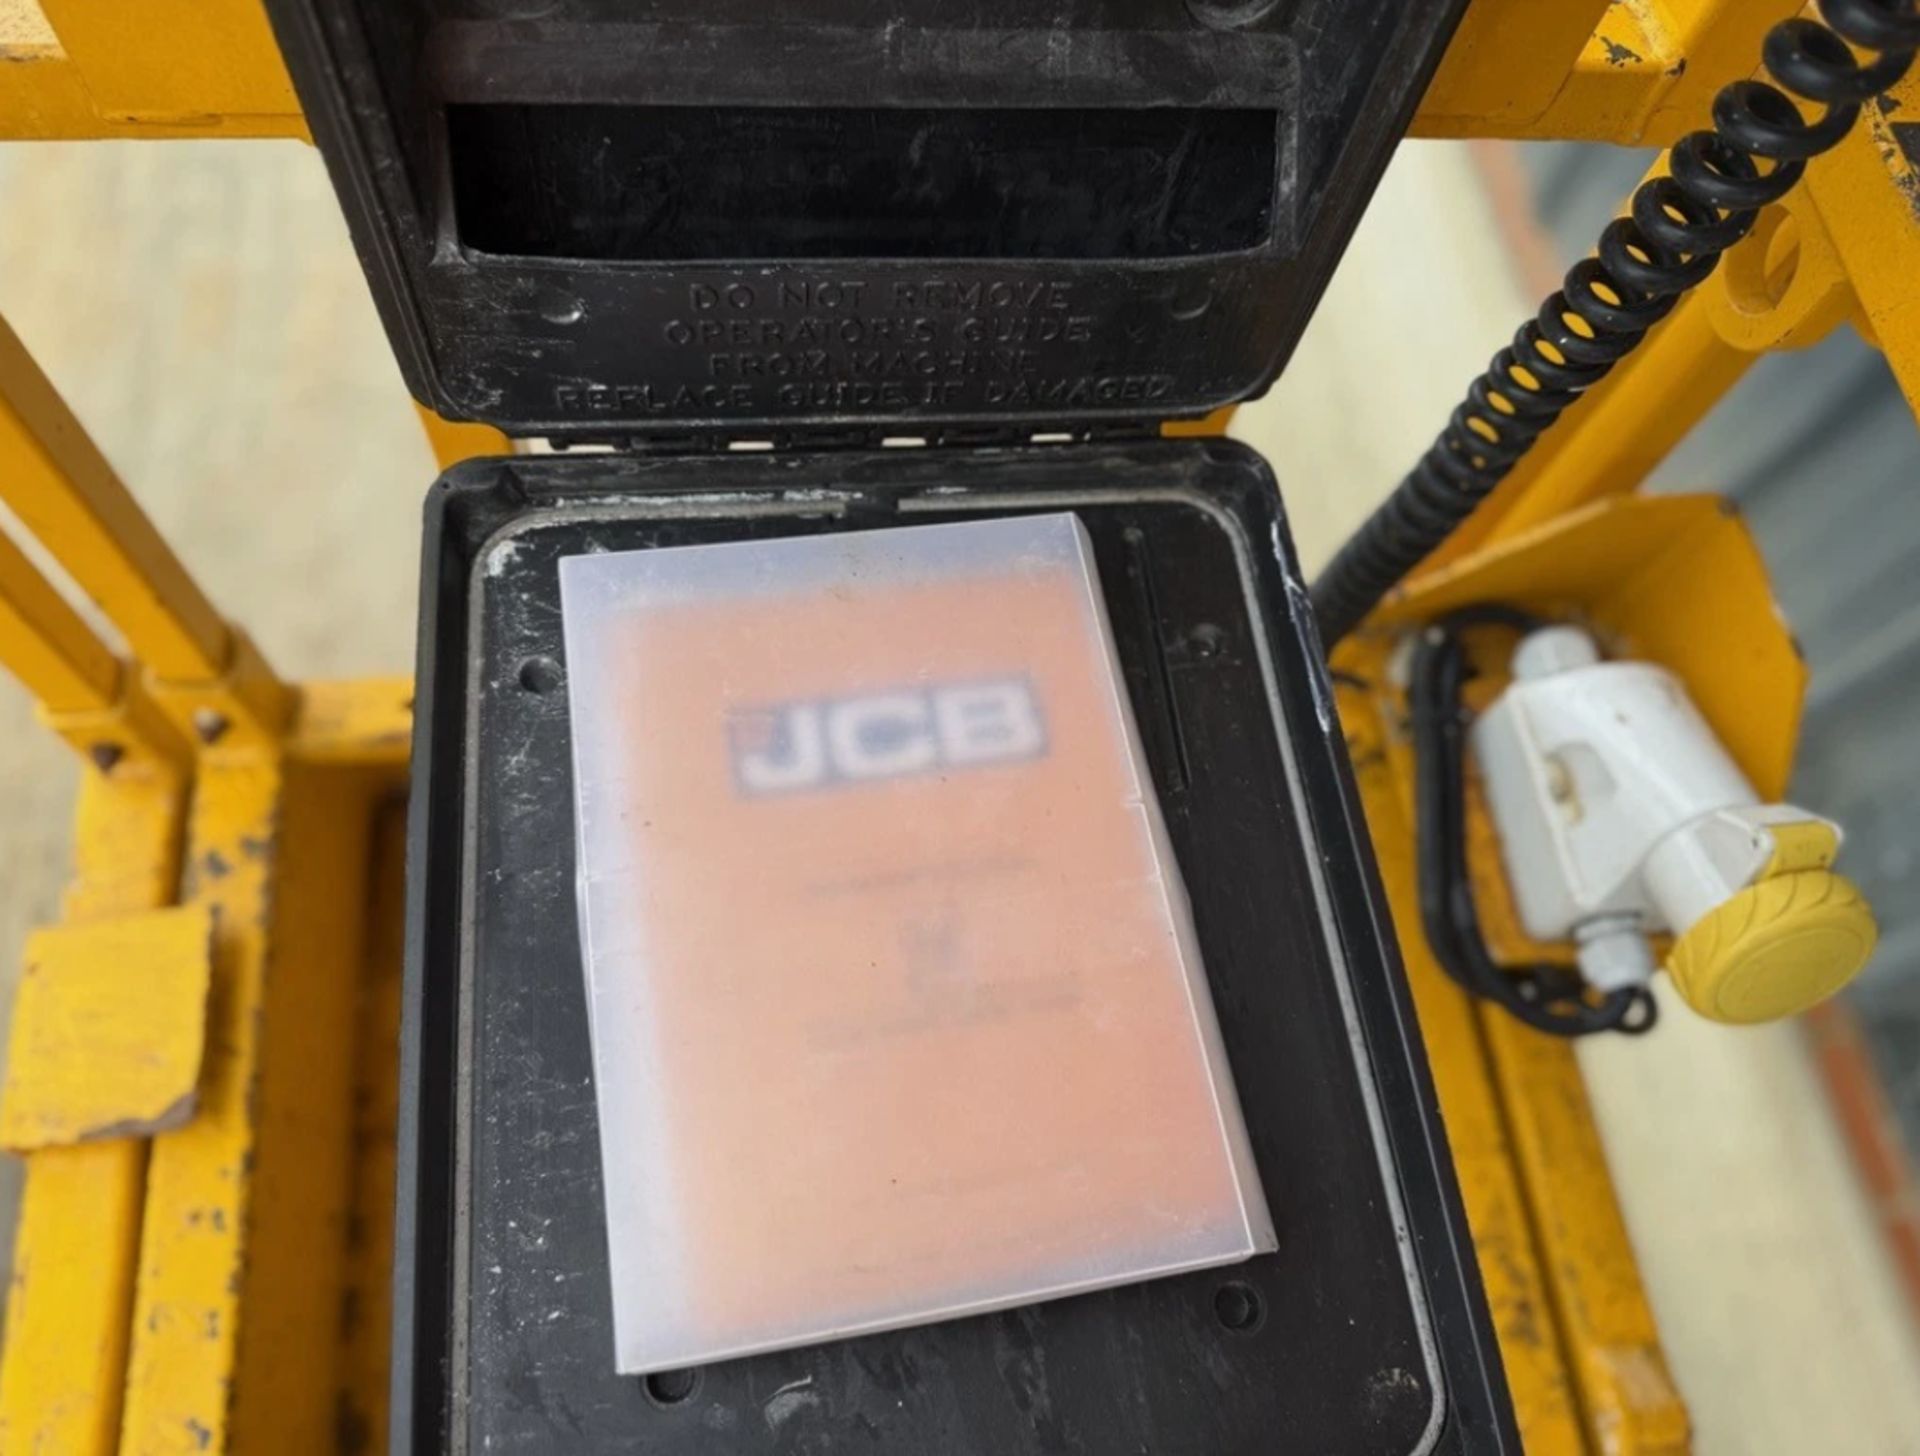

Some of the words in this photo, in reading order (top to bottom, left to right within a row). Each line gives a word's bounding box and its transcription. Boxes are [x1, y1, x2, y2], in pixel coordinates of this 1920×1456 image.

[689, 280, 755, 311] DO
[778, 280, 868, 310] NOT
[890, 279, 1073, 310] REMOVE
[663, 317, 938, 346] OPERATOR'S
[959, 315, 1092, 343] GUIDE
[708, 351, 831, 377] FROM
[852, 349, 1038, 376] MACHINE
[555, 383, 754, 411] REPLACE
[778, 381, 907, 408] GUIDE
[921, 380, 965, 405] IF
[984, 374, 1177, 404] DAMAGED
[735, 682, 1045, 792] JCB
